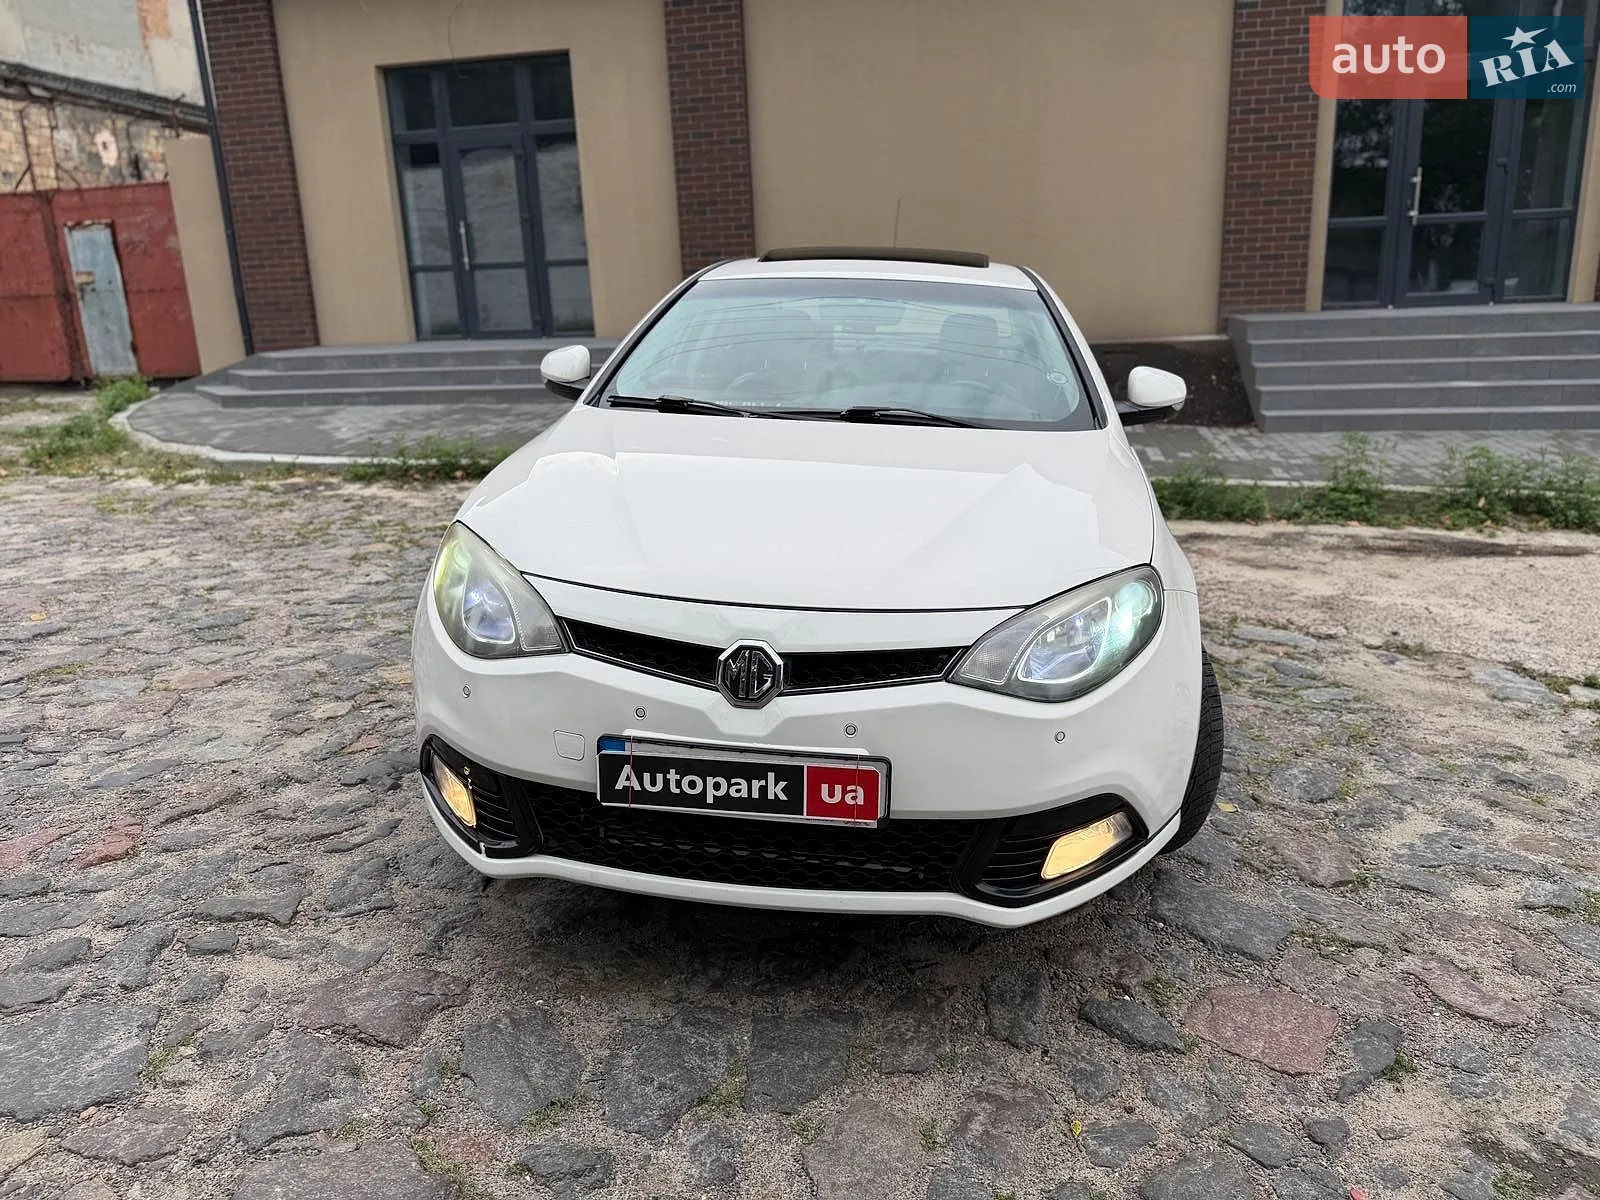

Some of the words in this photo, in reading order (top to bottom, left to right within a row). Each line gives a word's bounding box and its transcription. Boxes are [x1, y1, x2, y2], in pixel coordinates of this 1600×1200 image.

[725, 649, 773, 699] MG
[614, 764, 788, 804] Autopark
[820, 782, 865, 806] ua
